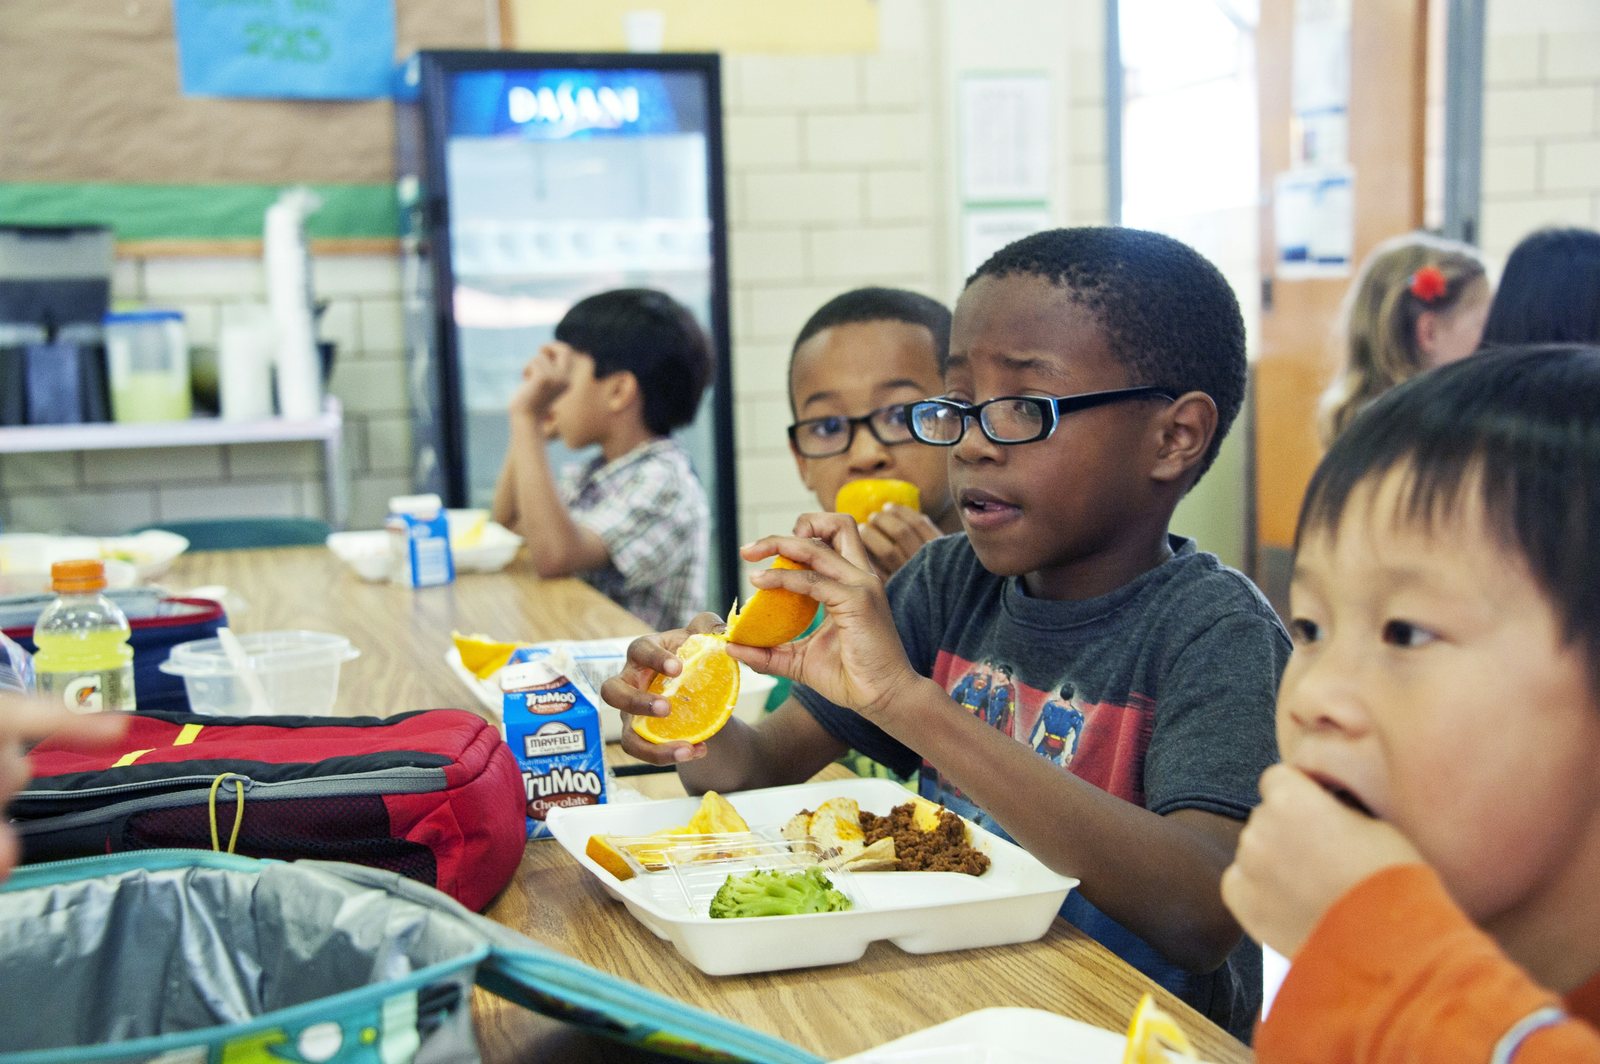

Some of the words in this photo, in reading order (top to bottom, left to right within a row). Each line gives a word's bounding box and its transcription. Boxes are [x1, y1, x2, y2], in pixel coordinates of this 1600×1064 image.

[508, 81, 639, 124] DASANI
[525, 692, 576, 707] TruMoo
[530, 734, 579, 748] MAYFIELD
[521, 768, 602, 800] TruMoo
[532, 796, 589, 811] Chocolate
